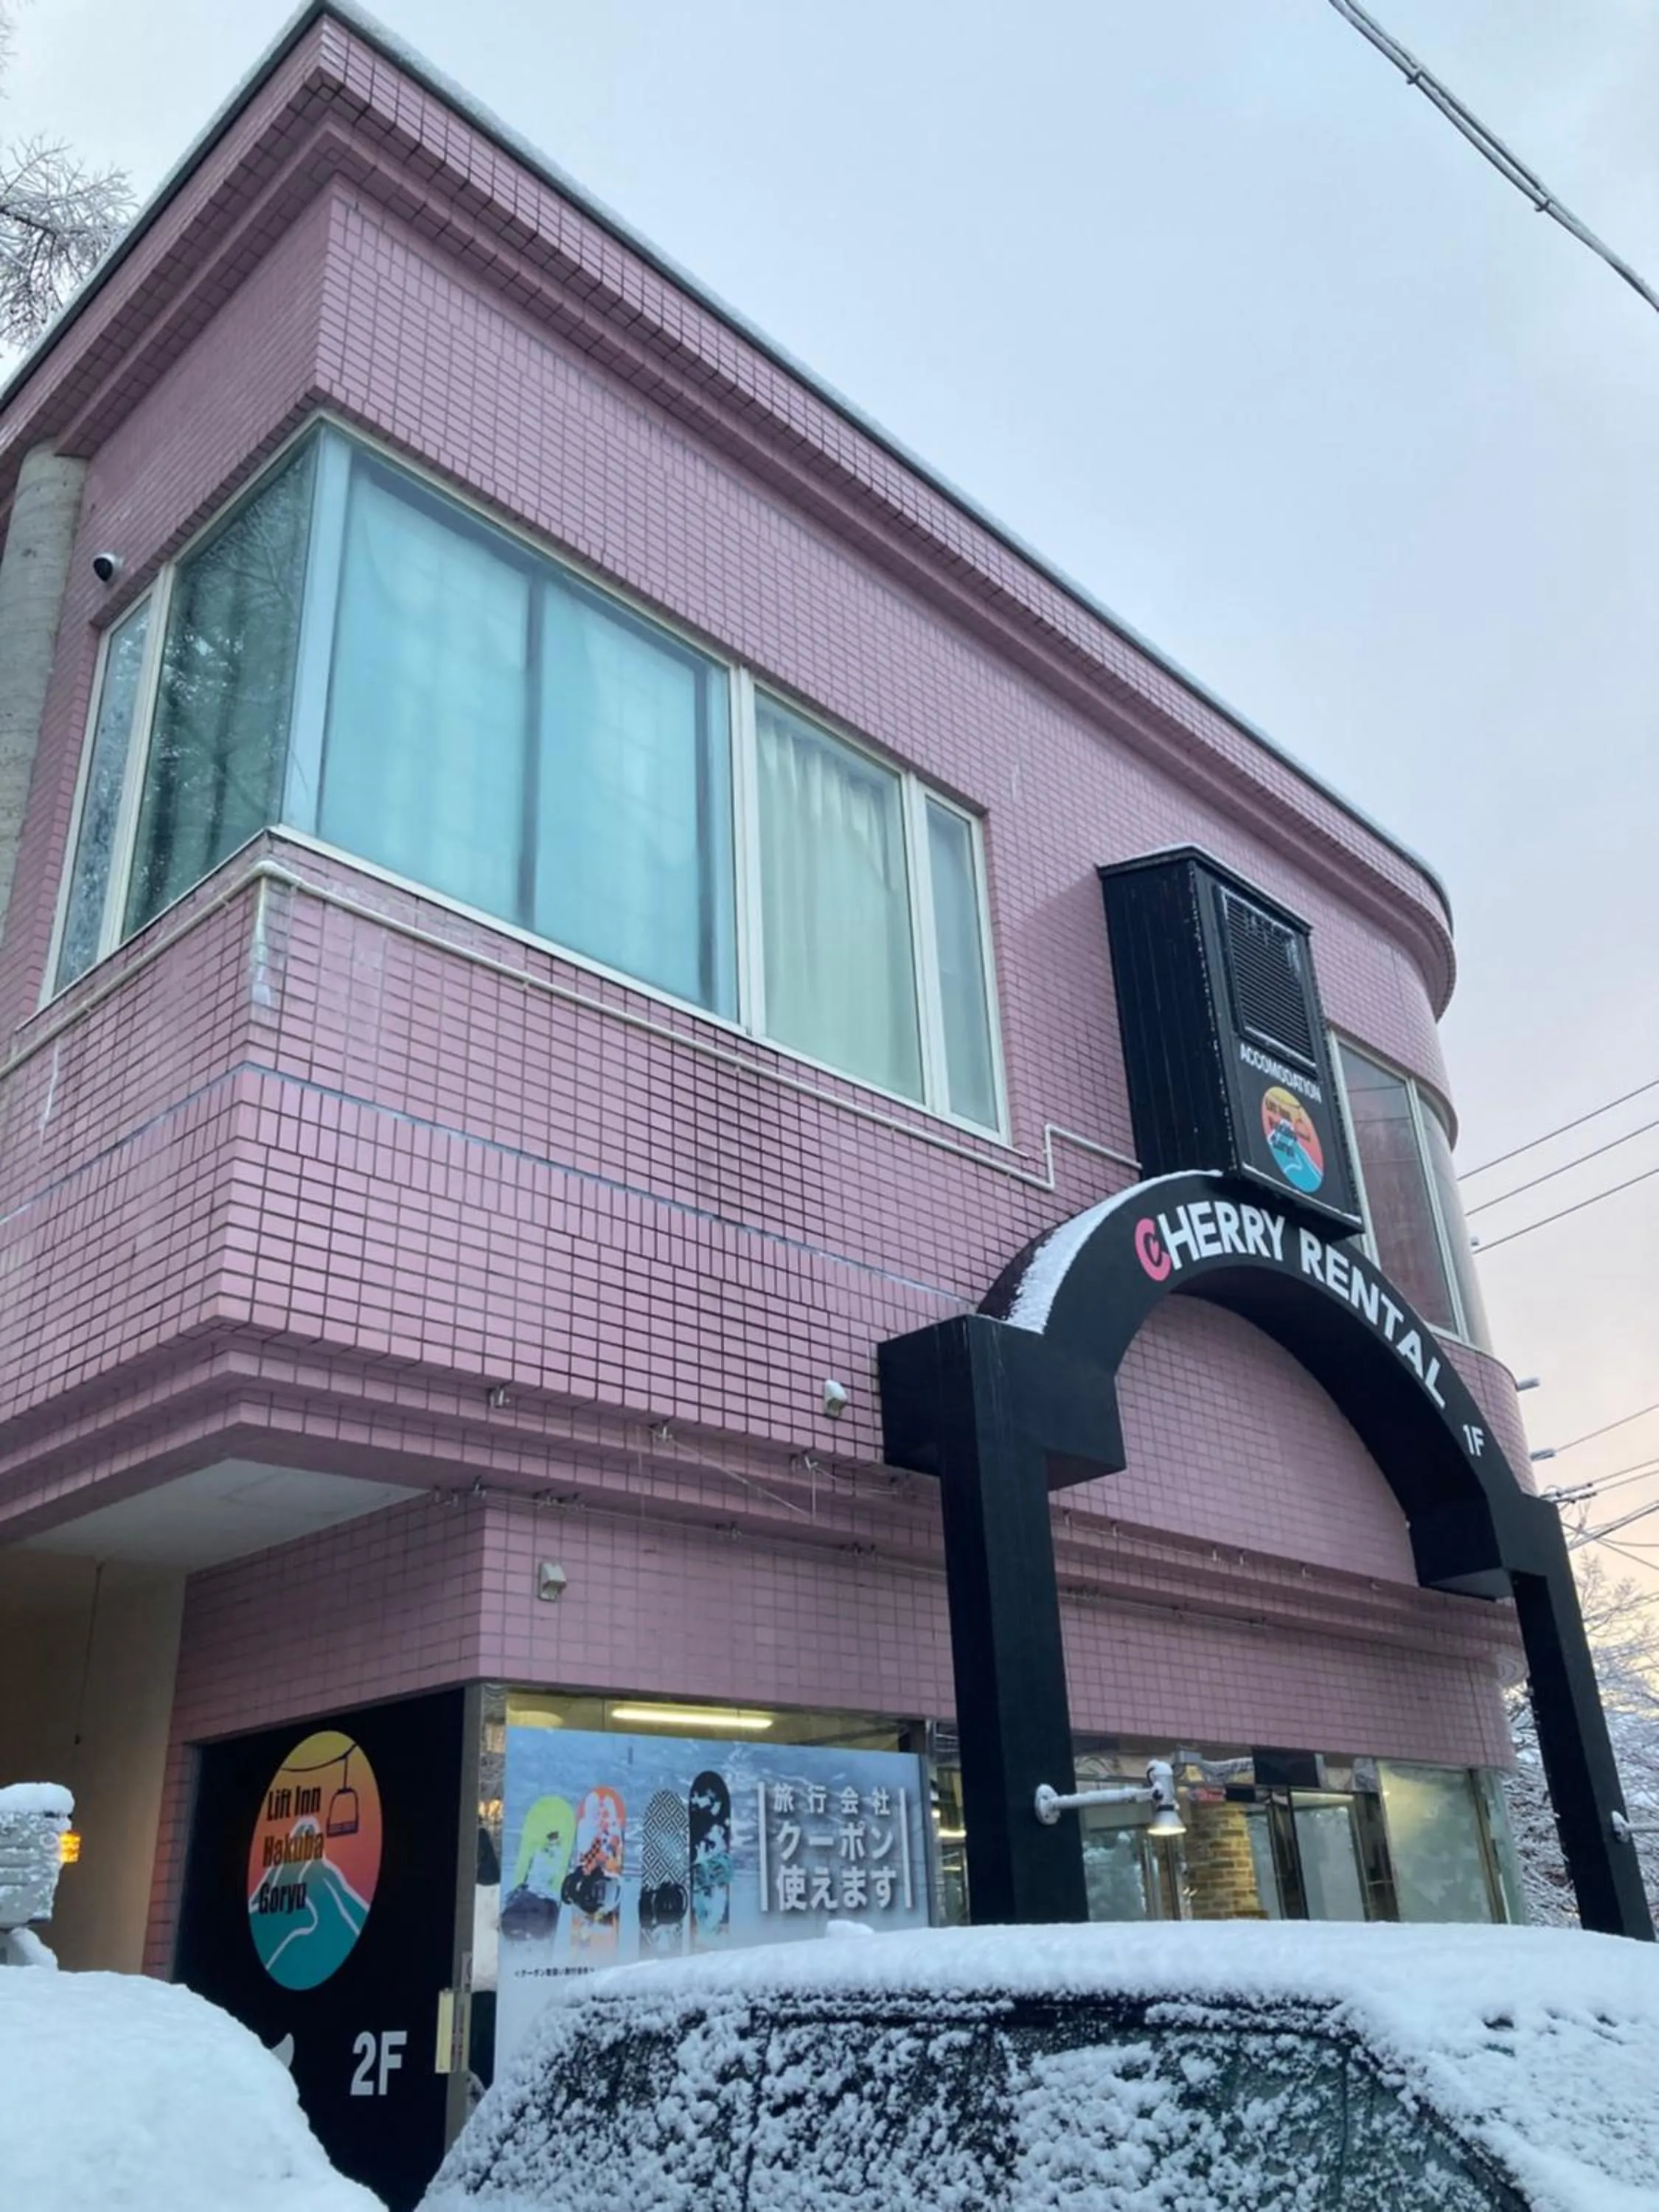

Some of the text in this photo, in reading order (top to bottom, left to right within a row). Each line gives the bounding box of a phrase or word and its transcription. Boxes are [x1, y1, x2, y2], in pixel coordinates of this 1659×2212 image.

[1135, 1200, 1484, 1457] CHERRY RENTAL 1F
[266, 1785, 321, 1821] Lift Inn
[773, 1782, 891, 1816] 旅行会社
[262, 1832, 324, 1868] Hakuba
[776, 1820, 893, 1861] クーポン
[258, 1882, 307, 1915] Goryu
[776, 1864, 896, 1911] 使えます
[349, 2031, 407, 2096] 2F
